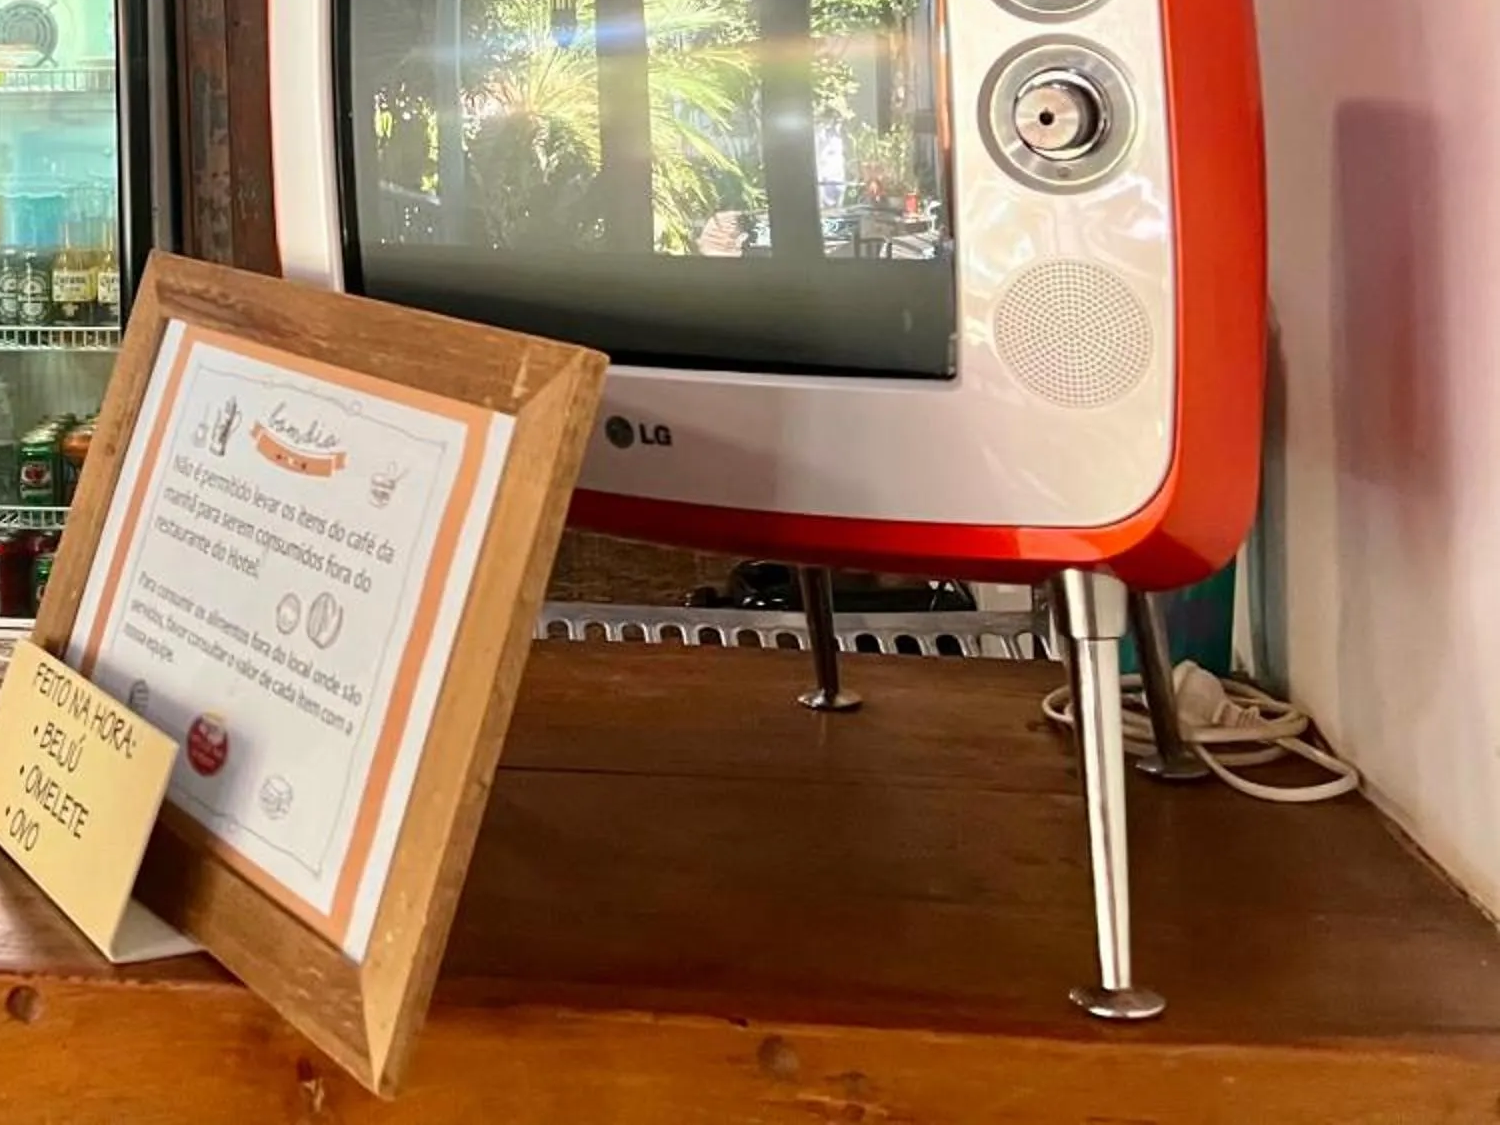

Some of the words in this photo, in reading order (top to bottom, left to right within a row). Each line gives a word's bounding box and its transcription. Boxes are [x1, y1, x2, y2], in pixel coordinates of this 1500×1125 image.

[639, 422, 673, 447] LG
[154, 515, 212, 555] restaurante
[211, 540, 228, 563] do
[173, 455, 194, 476] Não
[199, 465, 250, 504] permitido
[249, 488, 281, 516] levar
[280, 503, 297, 522] os
[296, 505, 327, 536] itens
[328, 519, 346, 542] do
[347, 529, 375, 556] café
[376, 539, 396, 565] da
[194, 498, 221, 523] para
[220, 511, 255, 539] serem
[255, 526, 324, 573] consumidos
[325, 552, 352, 585] fora
[352, 570, 373, 596] do
[33, 661, 73, 708] FEITO
[67, 687, 92, 726] NA
[186, 630, 229, 664] consultar
[235, 656, 260, 682] valor
[258, 669, 273, 691] de
[272, 678, 298, 704] cada
[320, 703, 347, 730] com
[250, 631, 272, 658] fora
[271, 644, 287, 666] do
[286, 650, 314, 680] local
[312, 669, 342, 696] onde
[342, 683, 363, 708] são
[8, 807, 41, 852] OVO
[24, 764, 90, 840] OMELETE
